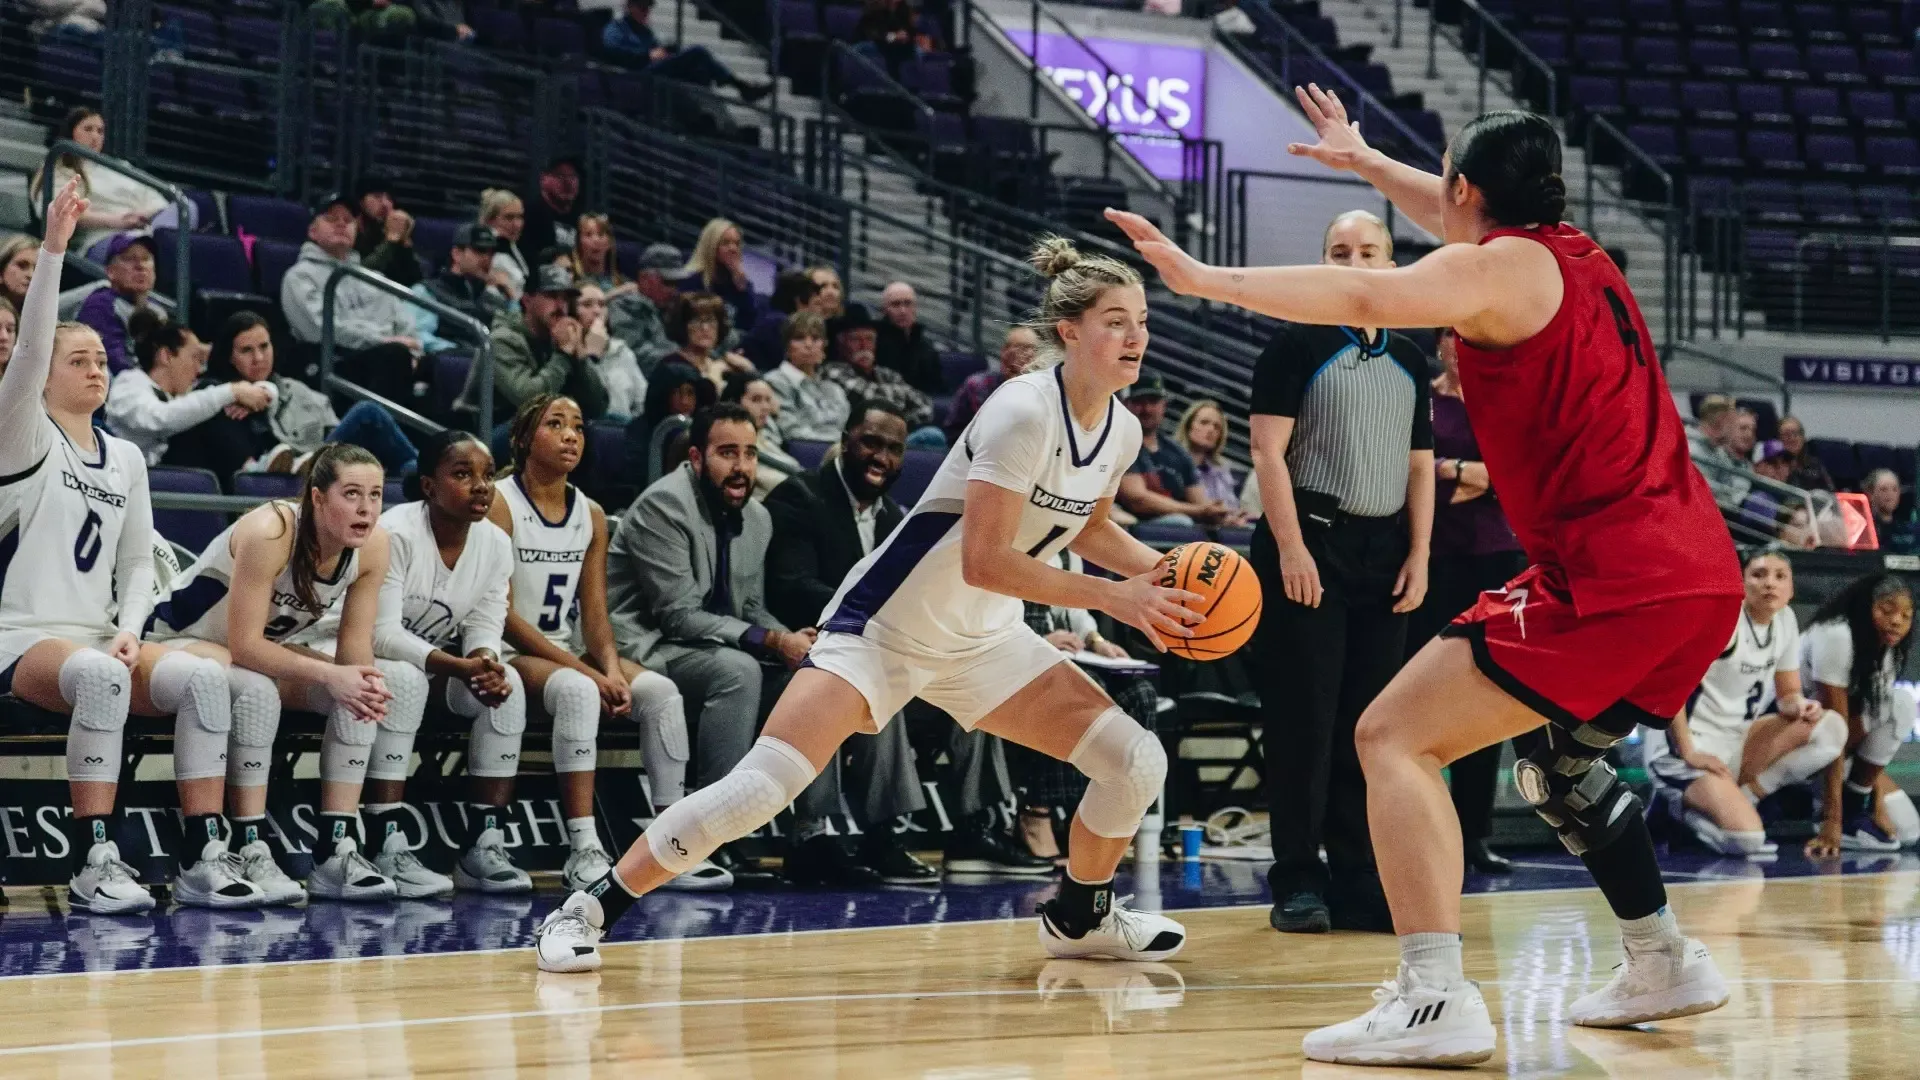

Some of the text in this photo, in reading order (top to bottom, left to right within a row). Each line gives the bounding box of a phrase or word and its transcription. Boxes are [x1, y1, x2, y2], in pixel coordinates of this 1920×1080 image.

[1041, 66, 1191, 129] EXUS
[74, 508, 103, 573] 0
[538, 574, 568, 631] 5
[1744, 681, 1763, 720] 2
